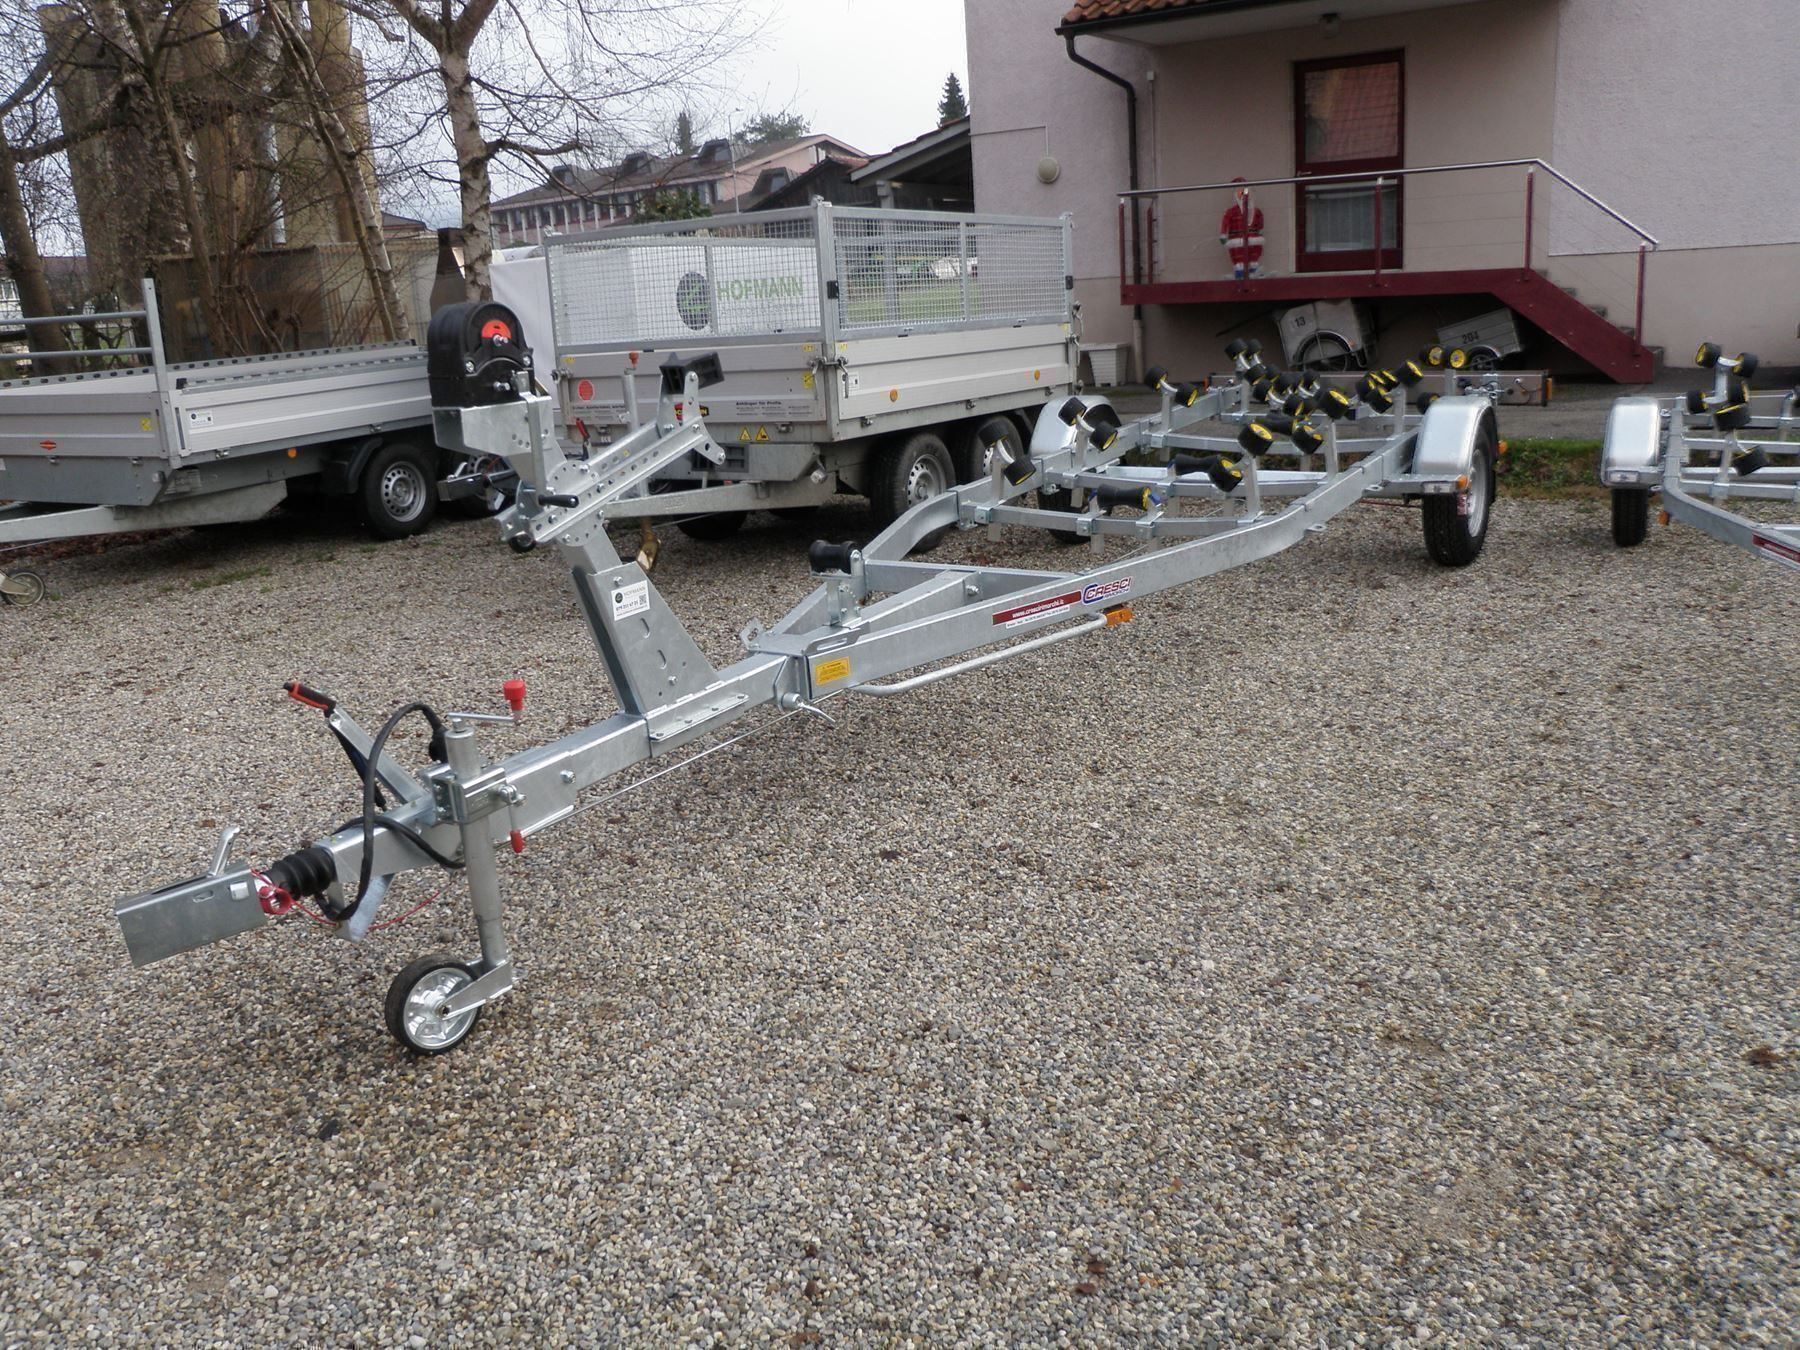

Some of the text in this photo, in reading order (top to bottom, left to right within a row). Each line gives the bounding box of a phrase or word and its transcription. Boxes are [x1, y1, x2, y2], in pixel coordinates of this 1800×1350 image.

[717, 277, 803, 300] HOFMANN
[1295, 316, 1306, 328] 13
[1084, 578, 1131, 603] CRESCI
